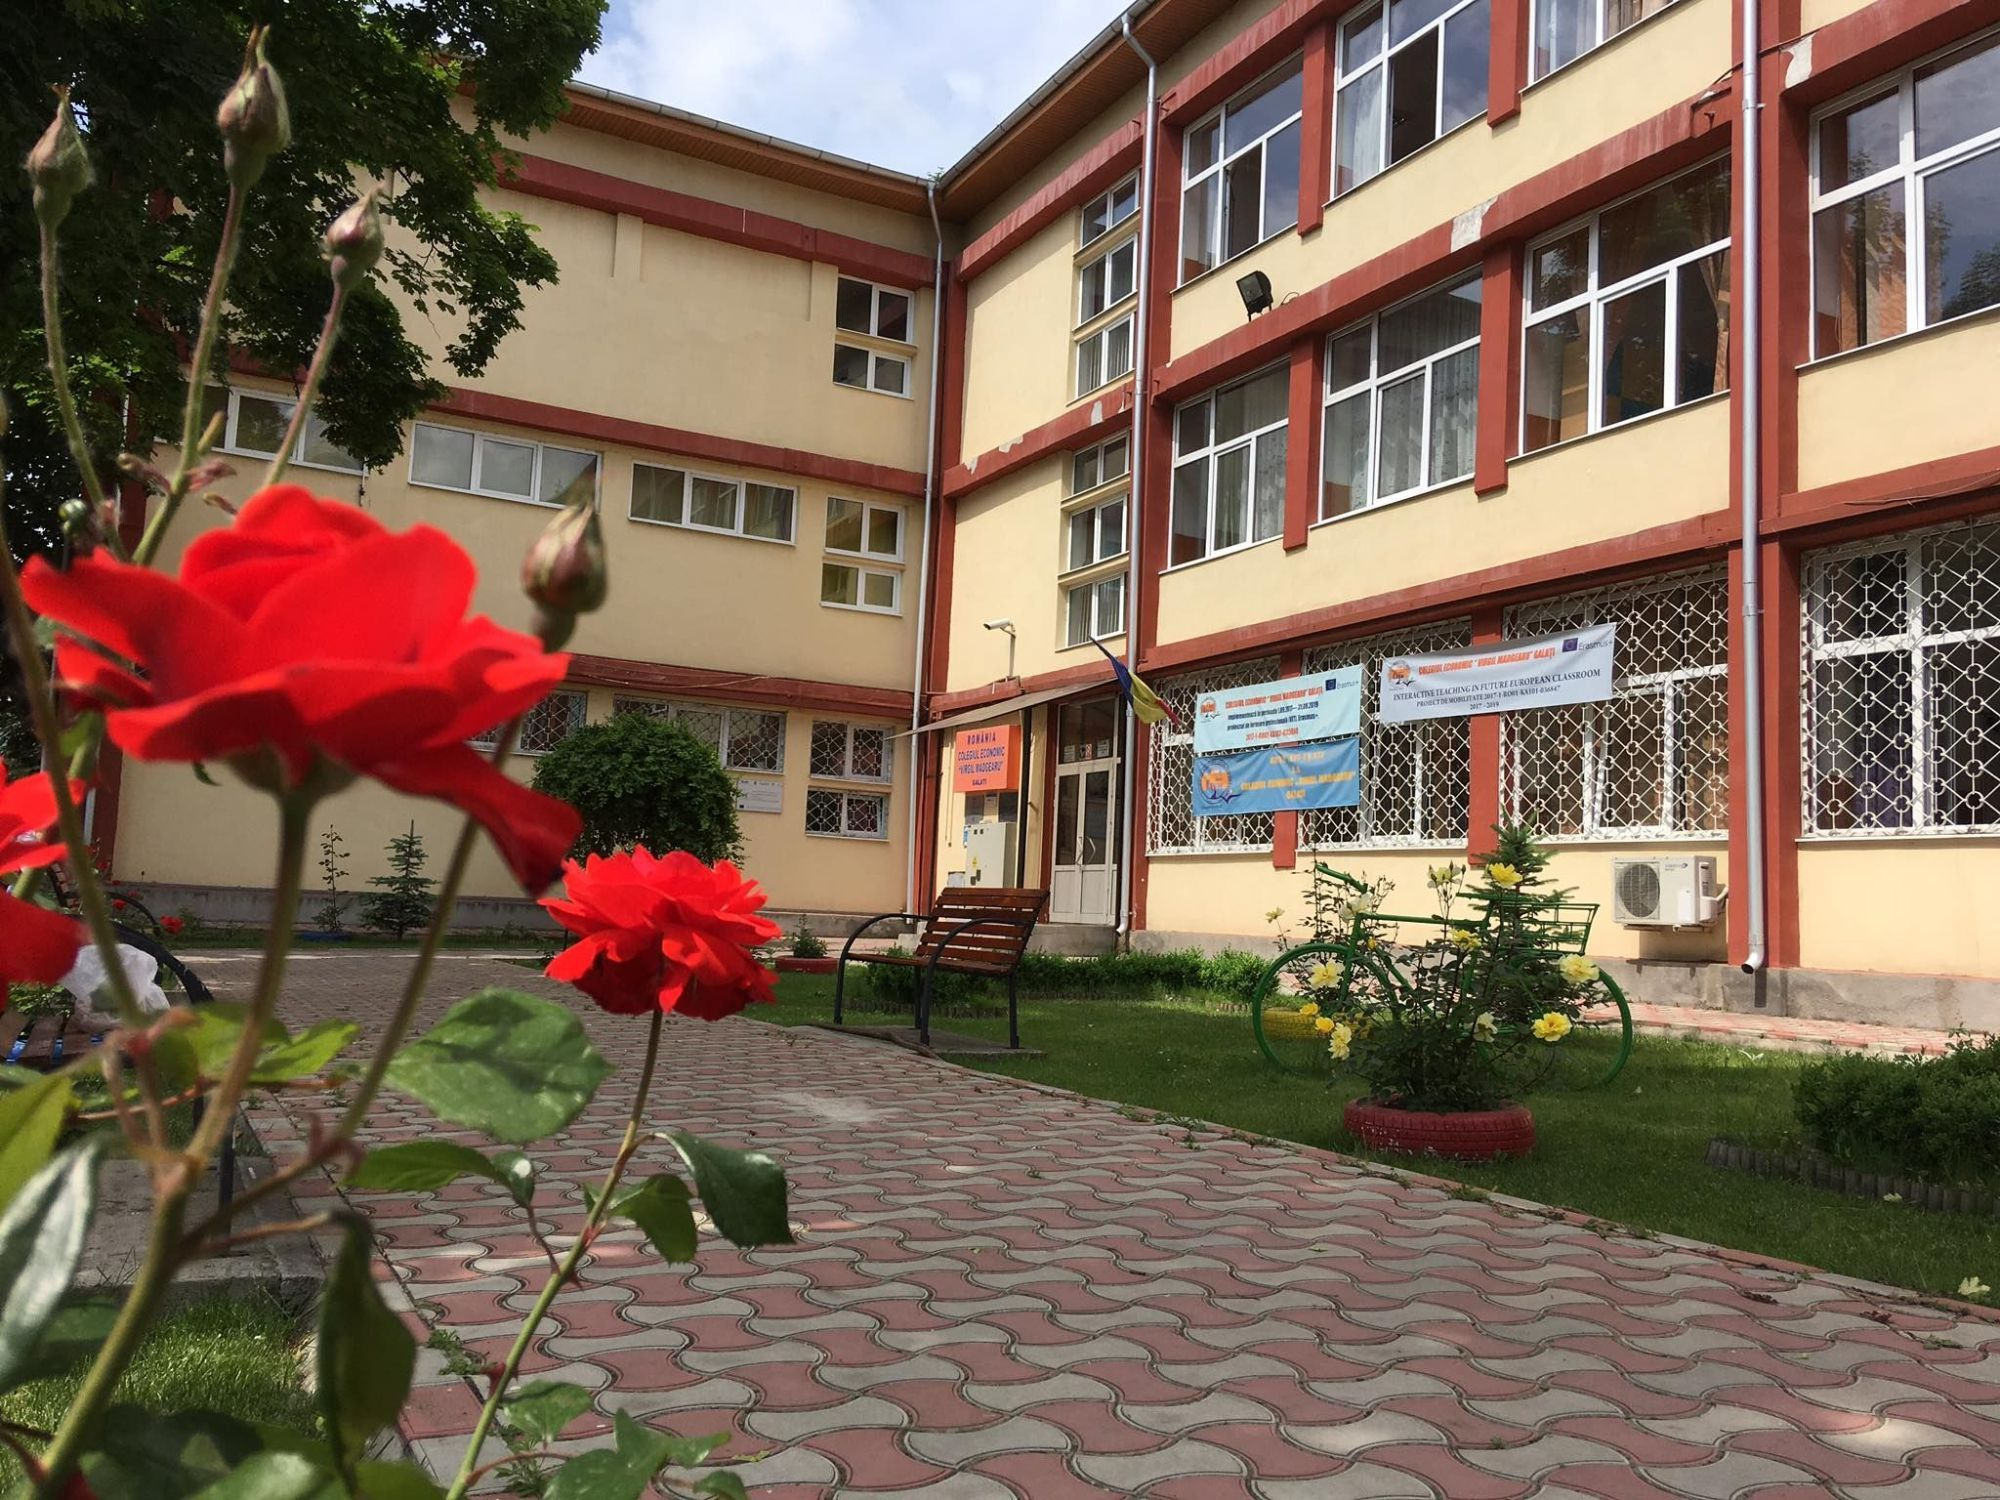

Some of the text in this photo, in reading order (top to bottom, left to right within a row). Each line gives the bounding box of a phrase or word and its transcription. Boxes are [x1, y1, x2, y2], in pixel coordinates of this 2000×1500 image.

[1579, 641, 1612, 651] Erasmus+
[1443, 660, 1473, 672] ECONOMIC
[1393, 668, 1600, 700] INTERACTIVE TEACHING IN FUTURE EUROPEAN CLASSROOM
[1449, 693, 1482, 703] MOBILITATE
